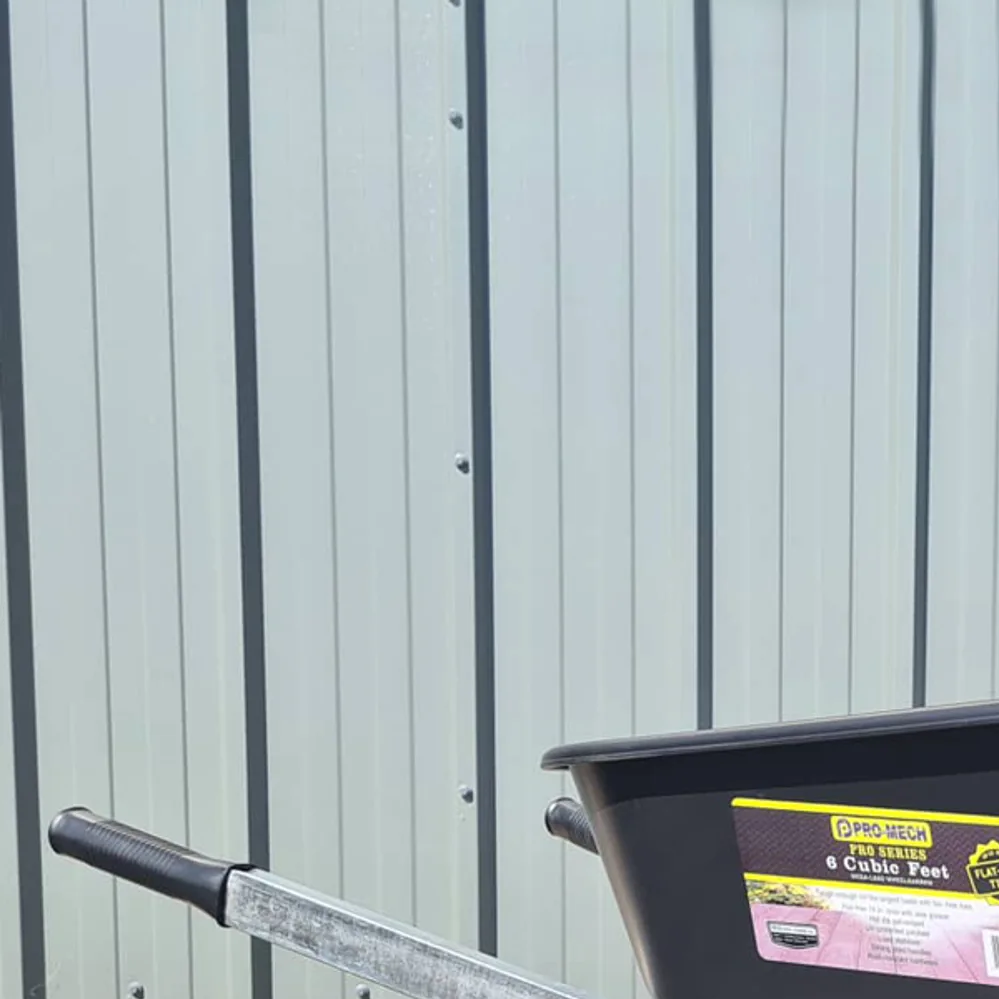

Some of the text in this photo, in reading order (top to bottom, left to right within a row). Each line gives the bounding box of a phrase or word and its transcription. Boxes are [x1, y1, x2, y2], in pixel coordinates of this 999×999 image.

[852, 821, 927, 842] PRO-MECH
[849, 843, 927, 861] PRO SERIES
[826, 855, 950, 879] 6 Cubic Feet
